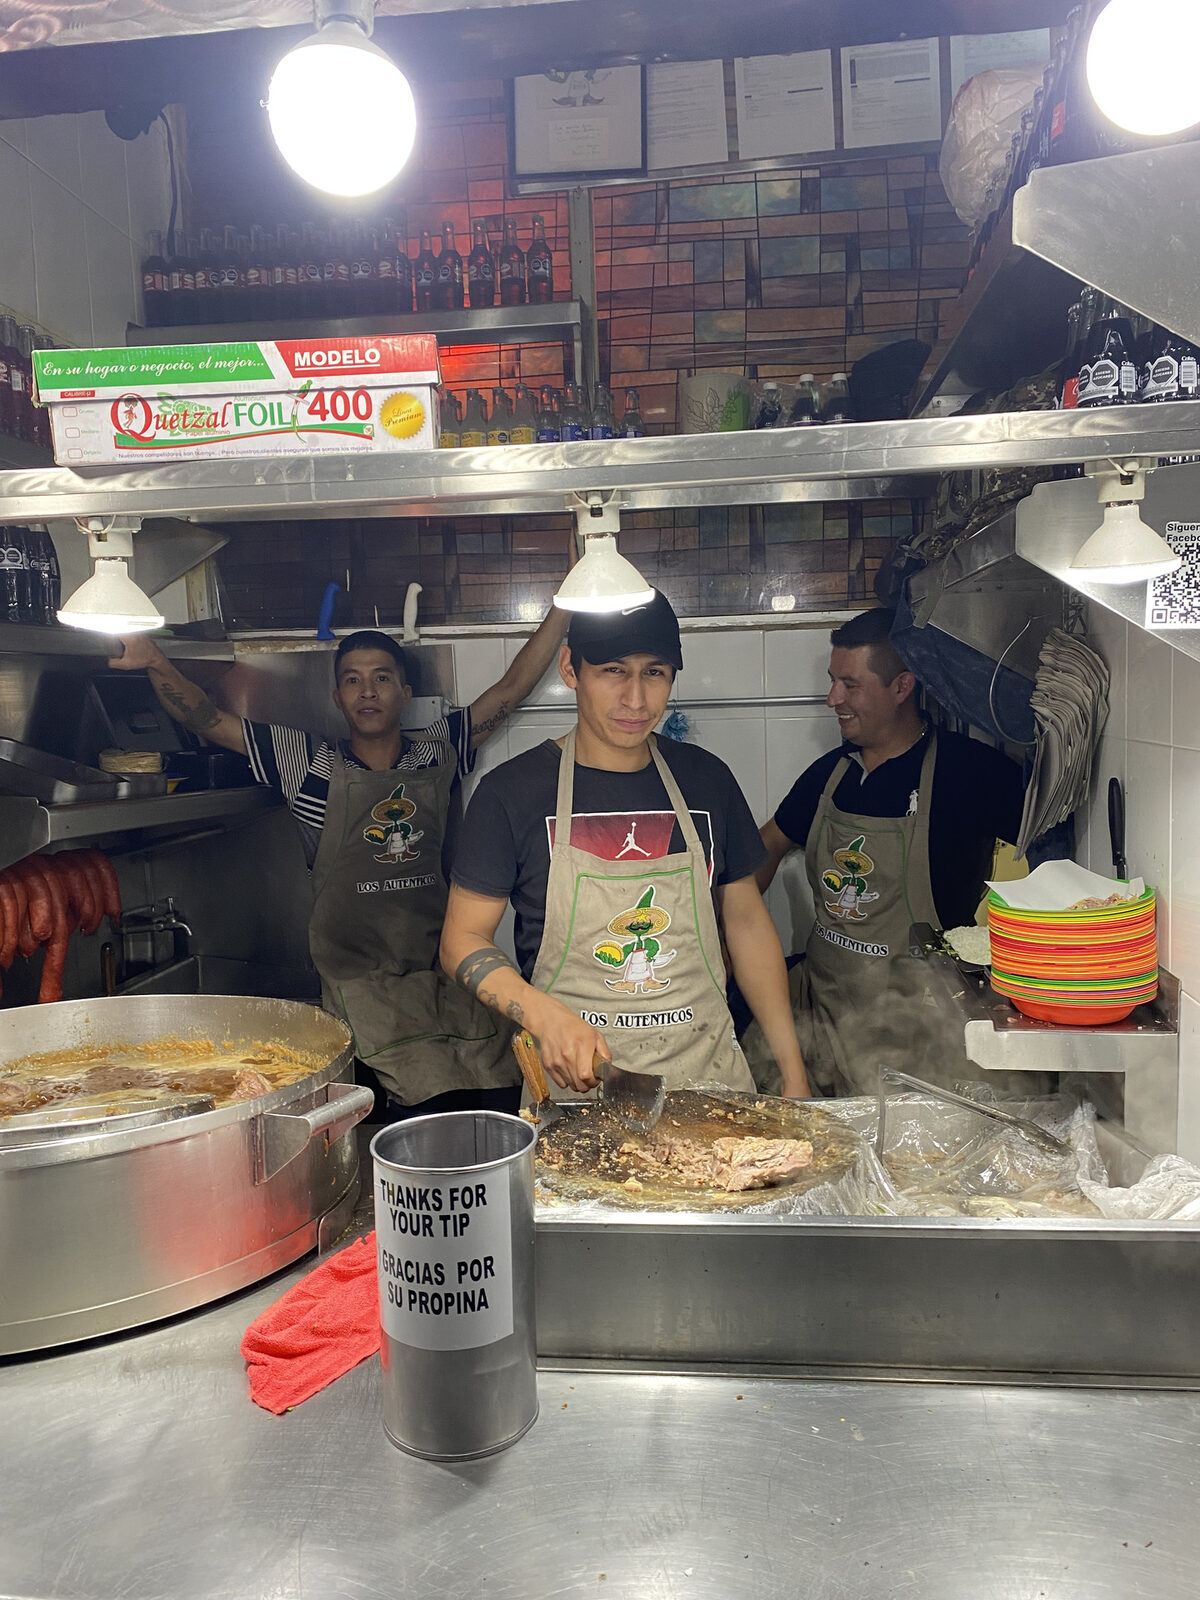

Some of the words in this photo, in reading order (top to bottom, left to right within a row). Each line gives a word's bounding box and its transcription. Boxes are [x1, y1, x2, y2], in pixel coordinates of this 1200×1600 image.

[42, 361, 64, 376] En
[65, 366, 83, 375] su
[85, 361, 127, 379] hogar
[129, 364, 138, 373] o
[140, 359, 195, 376] negocio,
[198, 356, 212, 369] el
[214, 357, 264, 374] mejor...
[294, 348, 381, 367] MODELO
[110, 392, 233, 443] Quetzal
[233, 401, 291, 427] FOIL
[307, 385, 373, 421] 400
[357, 882, 380, 893] LOS
[383, 874, 436, 891] AUTENTICOS
[825, 930, 889, 956] AUTENTICOS
[614, 1007, 694, 1028] AUTENTICOS
[380, 1178, 443, 1212] THANKS
[449, 1183, 487, 1211] FOR
[389, 1207, 434, 1238] YOUR
[439, 1212, 470, 1238] TIP
[382, 1249, 445, 1286] GRACIAS
[457, 1255, 495, 1285] POR
[387, 1280, 403, 1309] SU
[407, 1287, 489, 1316] PROPINA
